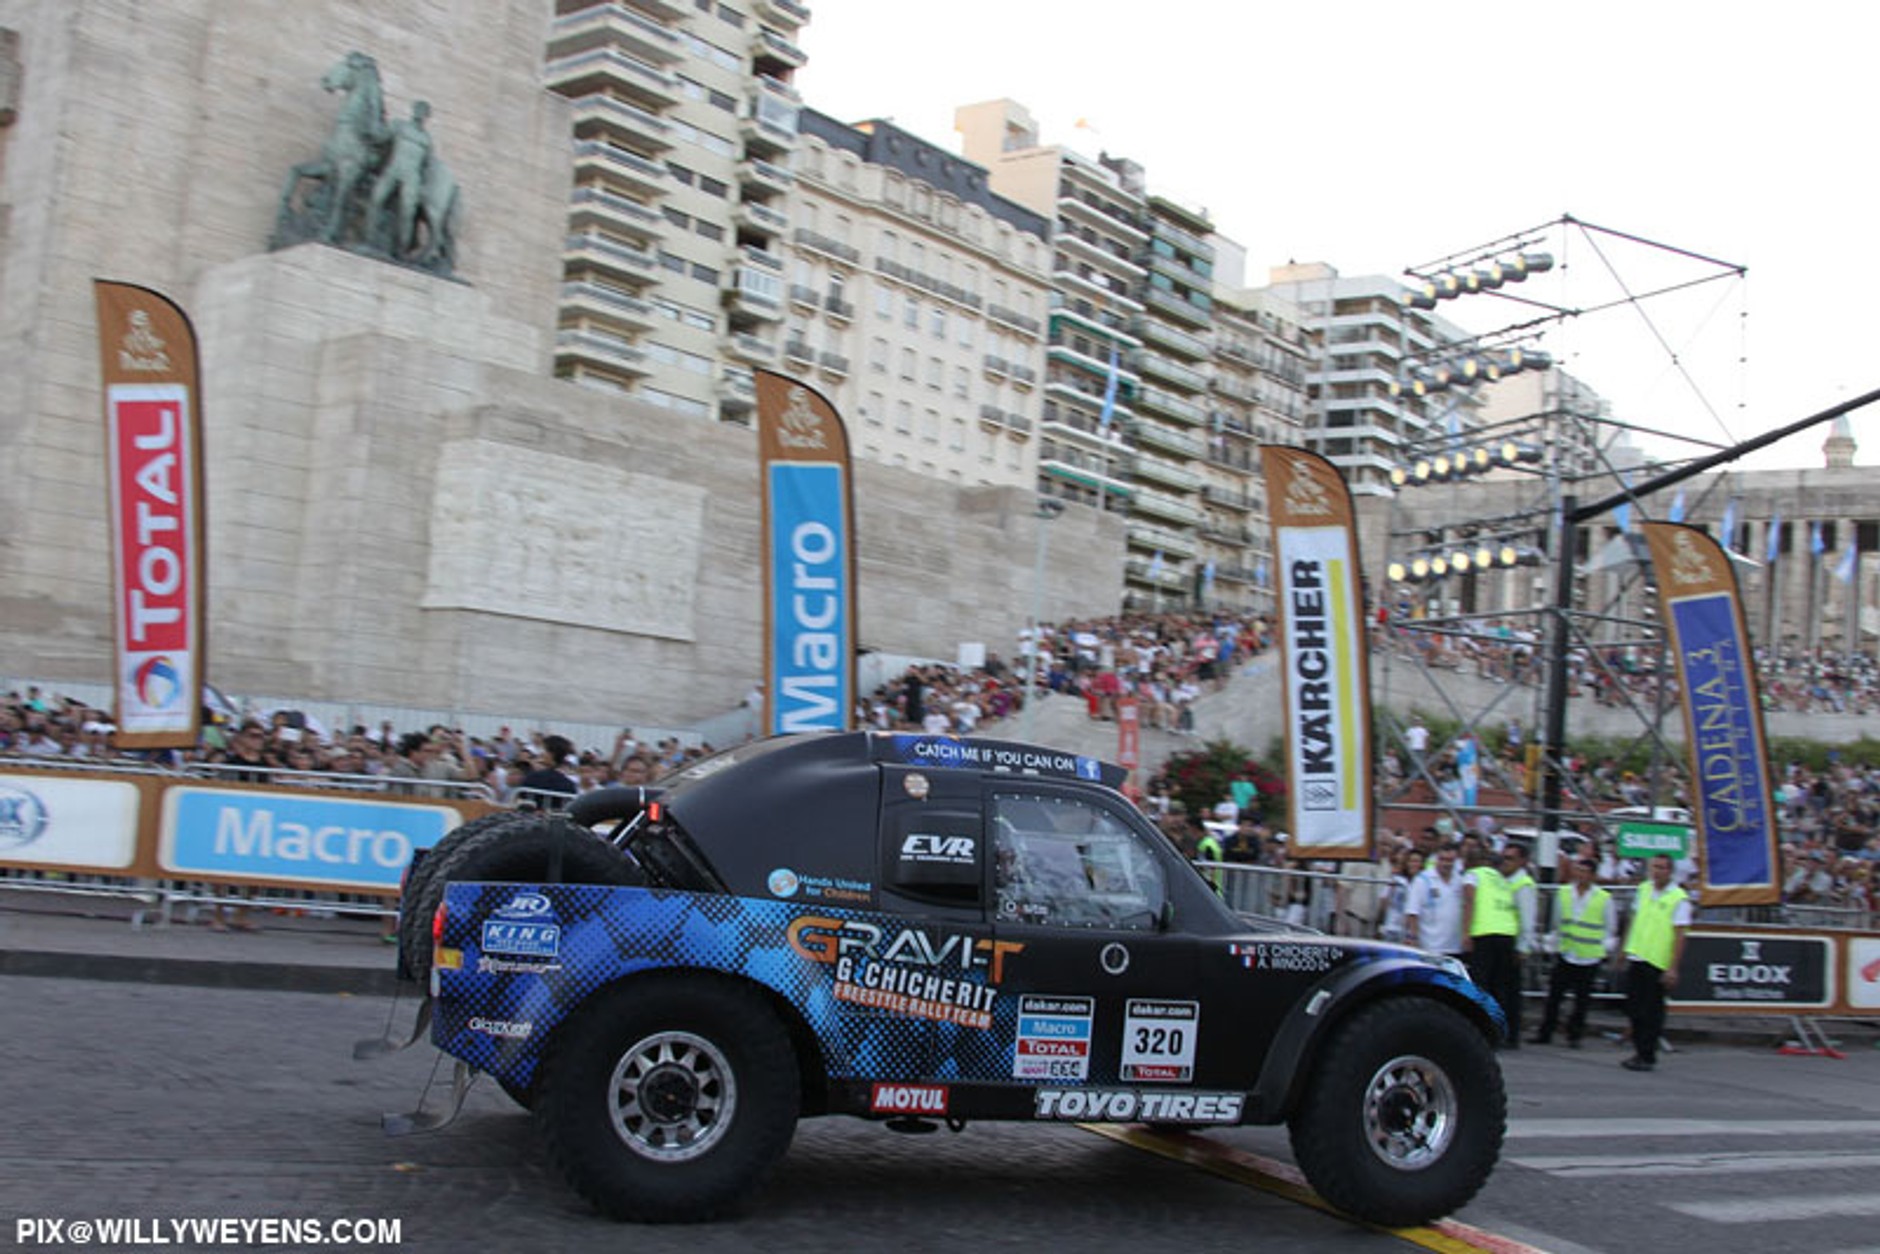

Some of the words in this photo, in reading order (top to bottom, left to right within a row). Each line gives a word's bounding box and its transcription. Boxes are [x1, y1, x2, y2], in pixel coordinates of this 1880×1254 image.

[131, 408, 181, 642] TOTAL
[779, 520, 839, 734] Macro
[1688, 647, 1714, 666] 3
[914, 743, 959, 759] CATCH
[960, 747, 979, 761] ME
[982, 749, 993, 762] IF
[995, 751, 1021, 765] YOU
[1023, 753, 1052, 767] CAN
[1054, 757, 1075, 770] ON
[1694, 677, 1741, 832] CADENA
[214, 805, 411, 869] Macro
[902, 834, 975, 857] EVR
[488, 925, 556, 942] KING
[1707, 963, 1792, 984] EDOX
[834, 981, 908, 1011] FREESTYLE
[909, 996, 951, 1021] RALLY
[952, 1006, 993, 1029] TEAM
[1024, 999, 1089, 1013] dakar.com
[1132, 1003, 1193, 1017] dakar.com
[1033, 1020, 1077, 1036] Macro
[1028, 1039, 1081, 1056] TOTAL
[1134, 1026, 1183, 1056] 320
[1137, 1066, 1177, 1079] TOTAL
[875, 1086, 944, 1110] MOTUL
[1037, 1089, 1139, 1119] TOYO
[1140, 1092, 1245, 1120] TIRES
